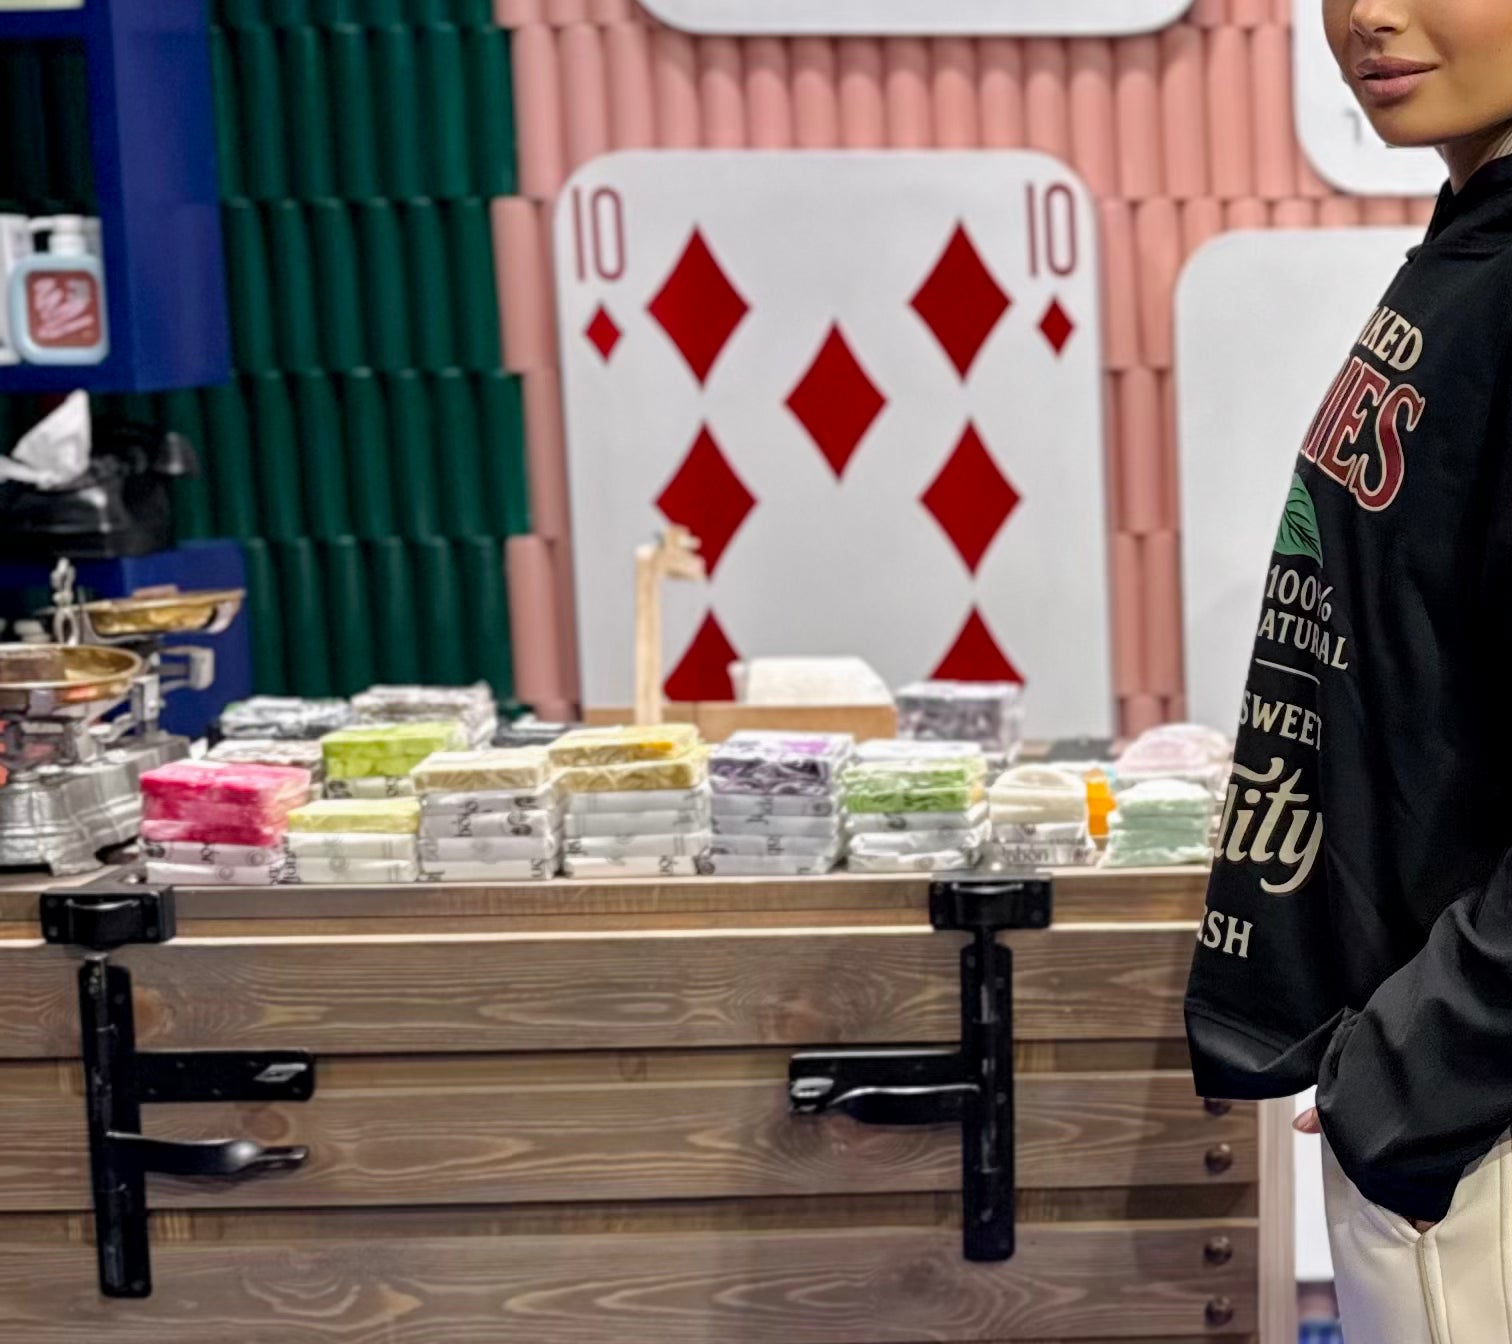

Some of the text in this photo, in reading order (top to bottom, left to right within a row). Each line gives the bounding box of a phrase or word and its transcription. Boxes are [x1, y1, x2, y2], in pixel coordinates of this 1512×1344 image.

[572, 186, 626, 283] 10
[1026, 181, 1077, 278] 10
[1358, 306, 1423, 371] KED
[1300, 355, 1426, 512] IES
[1266, 564, 1333, 622] 100%
[1257, 607, 1349, 670] ATURAL
[1214, 757, 1324, 893] lity
[1200, 908, 1253, 958] SH
